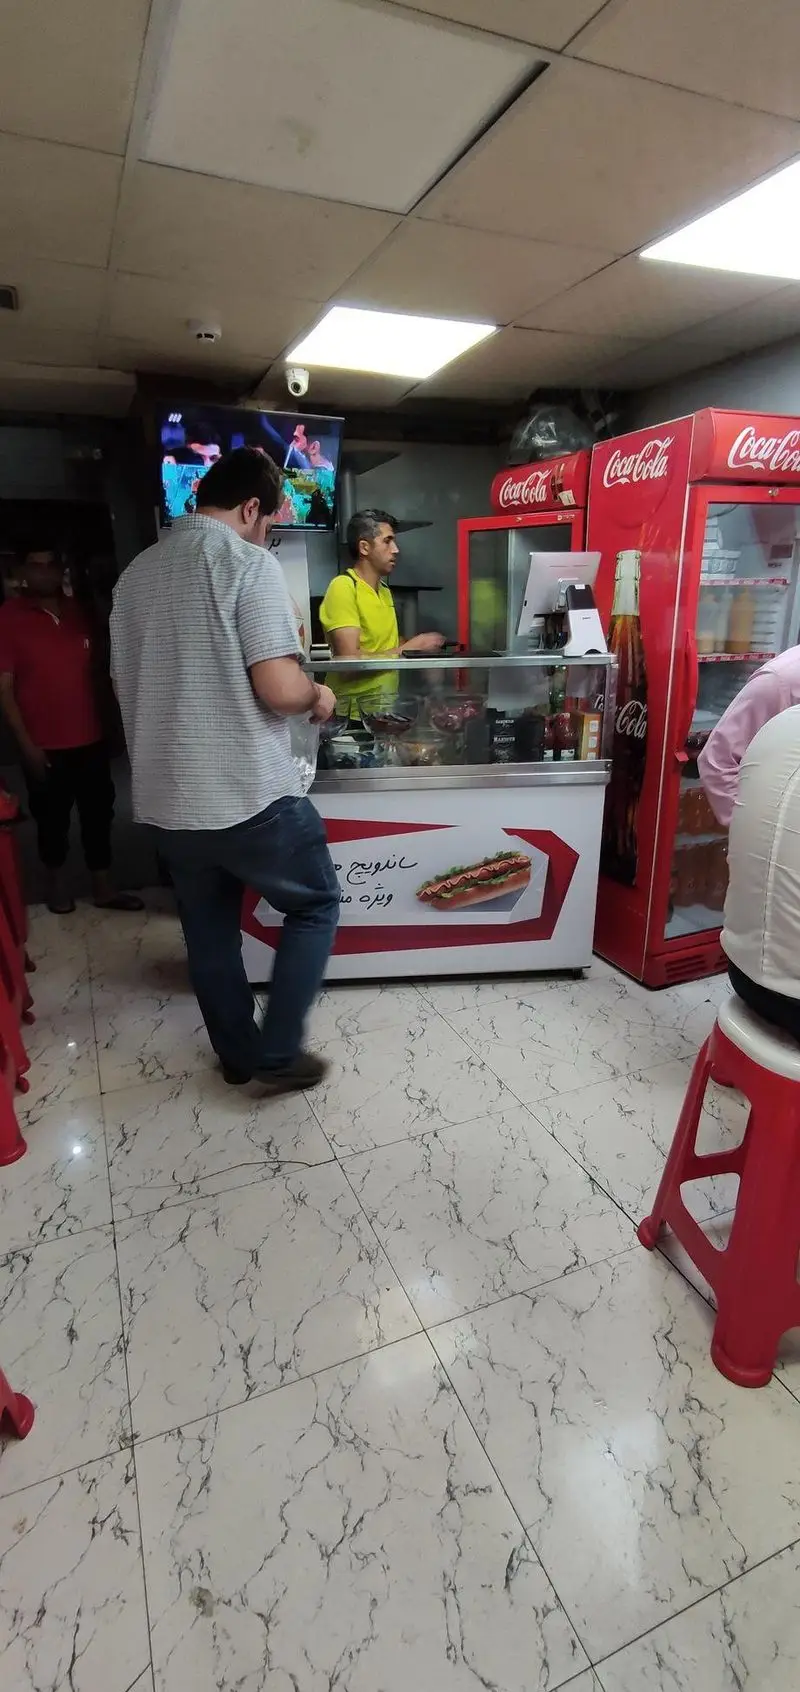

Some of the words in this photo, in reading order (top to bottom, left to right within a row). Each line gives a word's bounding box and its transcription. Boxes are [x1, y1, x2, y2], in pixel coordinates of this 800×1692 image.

[603, 436, 675, 488] Coca-Cola
[499, 469, 553, 508] Coca-Cola
[346, 854, 418, 885] ساندویچ
[359, 883, 393, 910] ویژه
